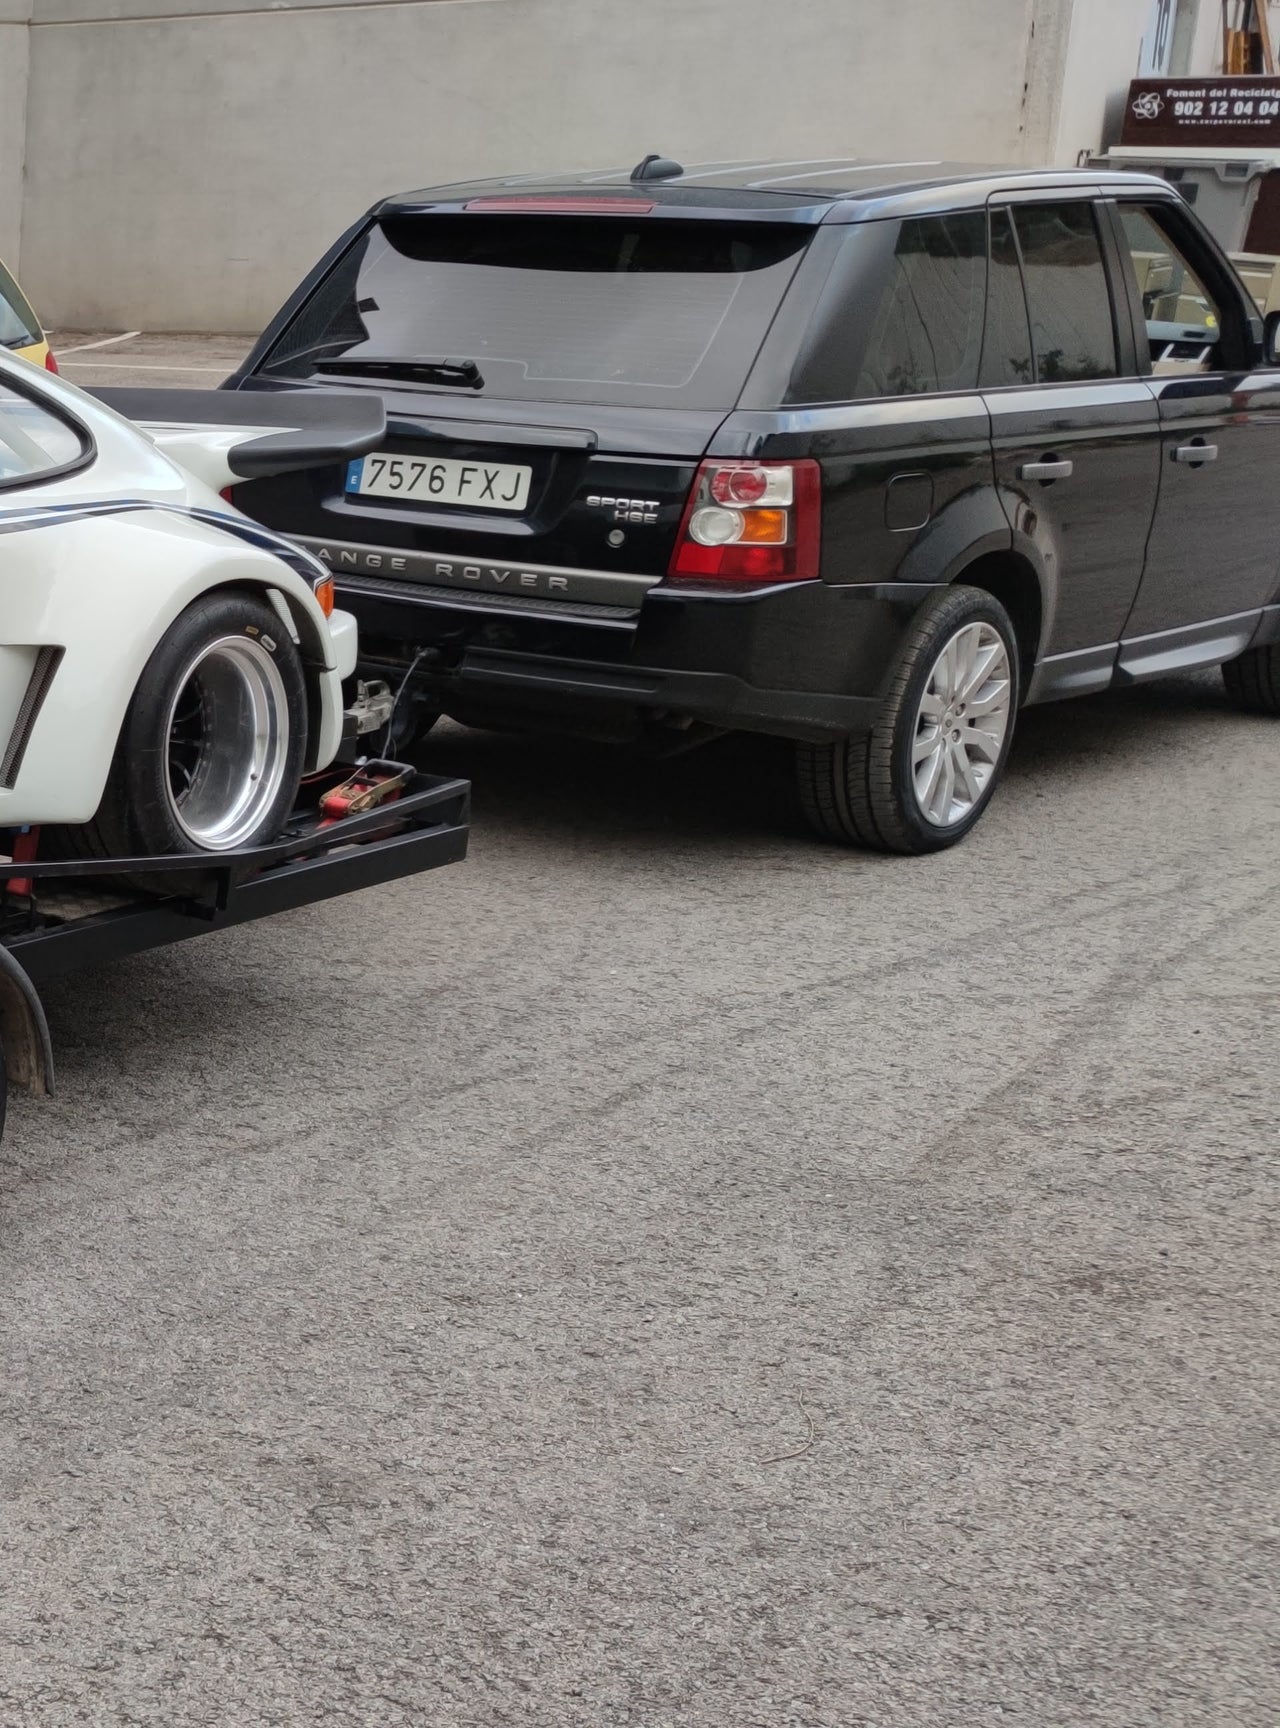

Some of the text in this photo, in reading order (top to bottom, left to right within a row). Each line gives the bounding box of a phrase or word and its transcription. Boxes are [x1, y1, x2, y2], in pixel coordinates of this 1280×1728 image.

[1166, 88, 1206, 98] Foment
[1209, 88, 1227, 98] del
[1174, 101, 1280, 116] 902 12 04 04
[350, 475, 358, 485] E
[367, 458, 522, 502] 7576 FXJ
[586, 495, 661, 512] SPORT
[613, 510, 659, 524] HSE
[312, 546, 569, 592] ANGE ROVER
